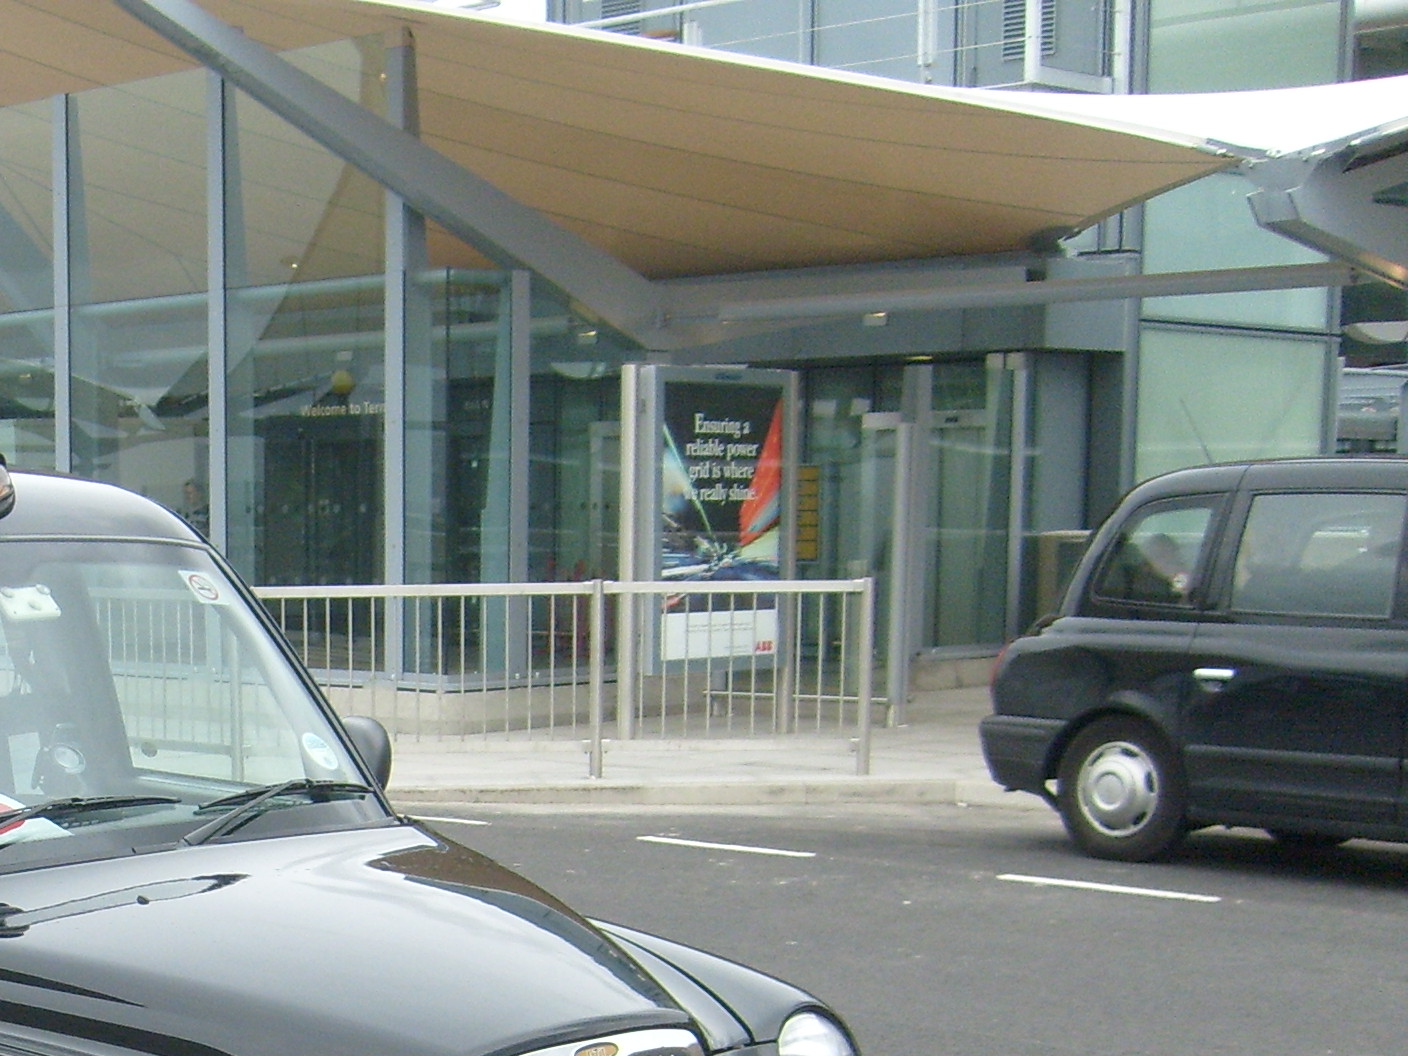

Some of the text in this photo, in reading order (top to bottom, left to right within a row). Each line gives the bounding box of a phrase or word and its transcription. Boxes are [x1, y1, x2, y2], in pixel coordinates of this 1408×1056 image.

[300, 403, 347, 417] Welcome
[350, 403, 361, 415] to
[694, 412, 751, 439] Ensuring a
[685, 438, 760, 461] reliable power
[689, 460, 755, 483] grid is where
[699, 483, 728, 506] really
[754, 640, 774, 652] ABB
